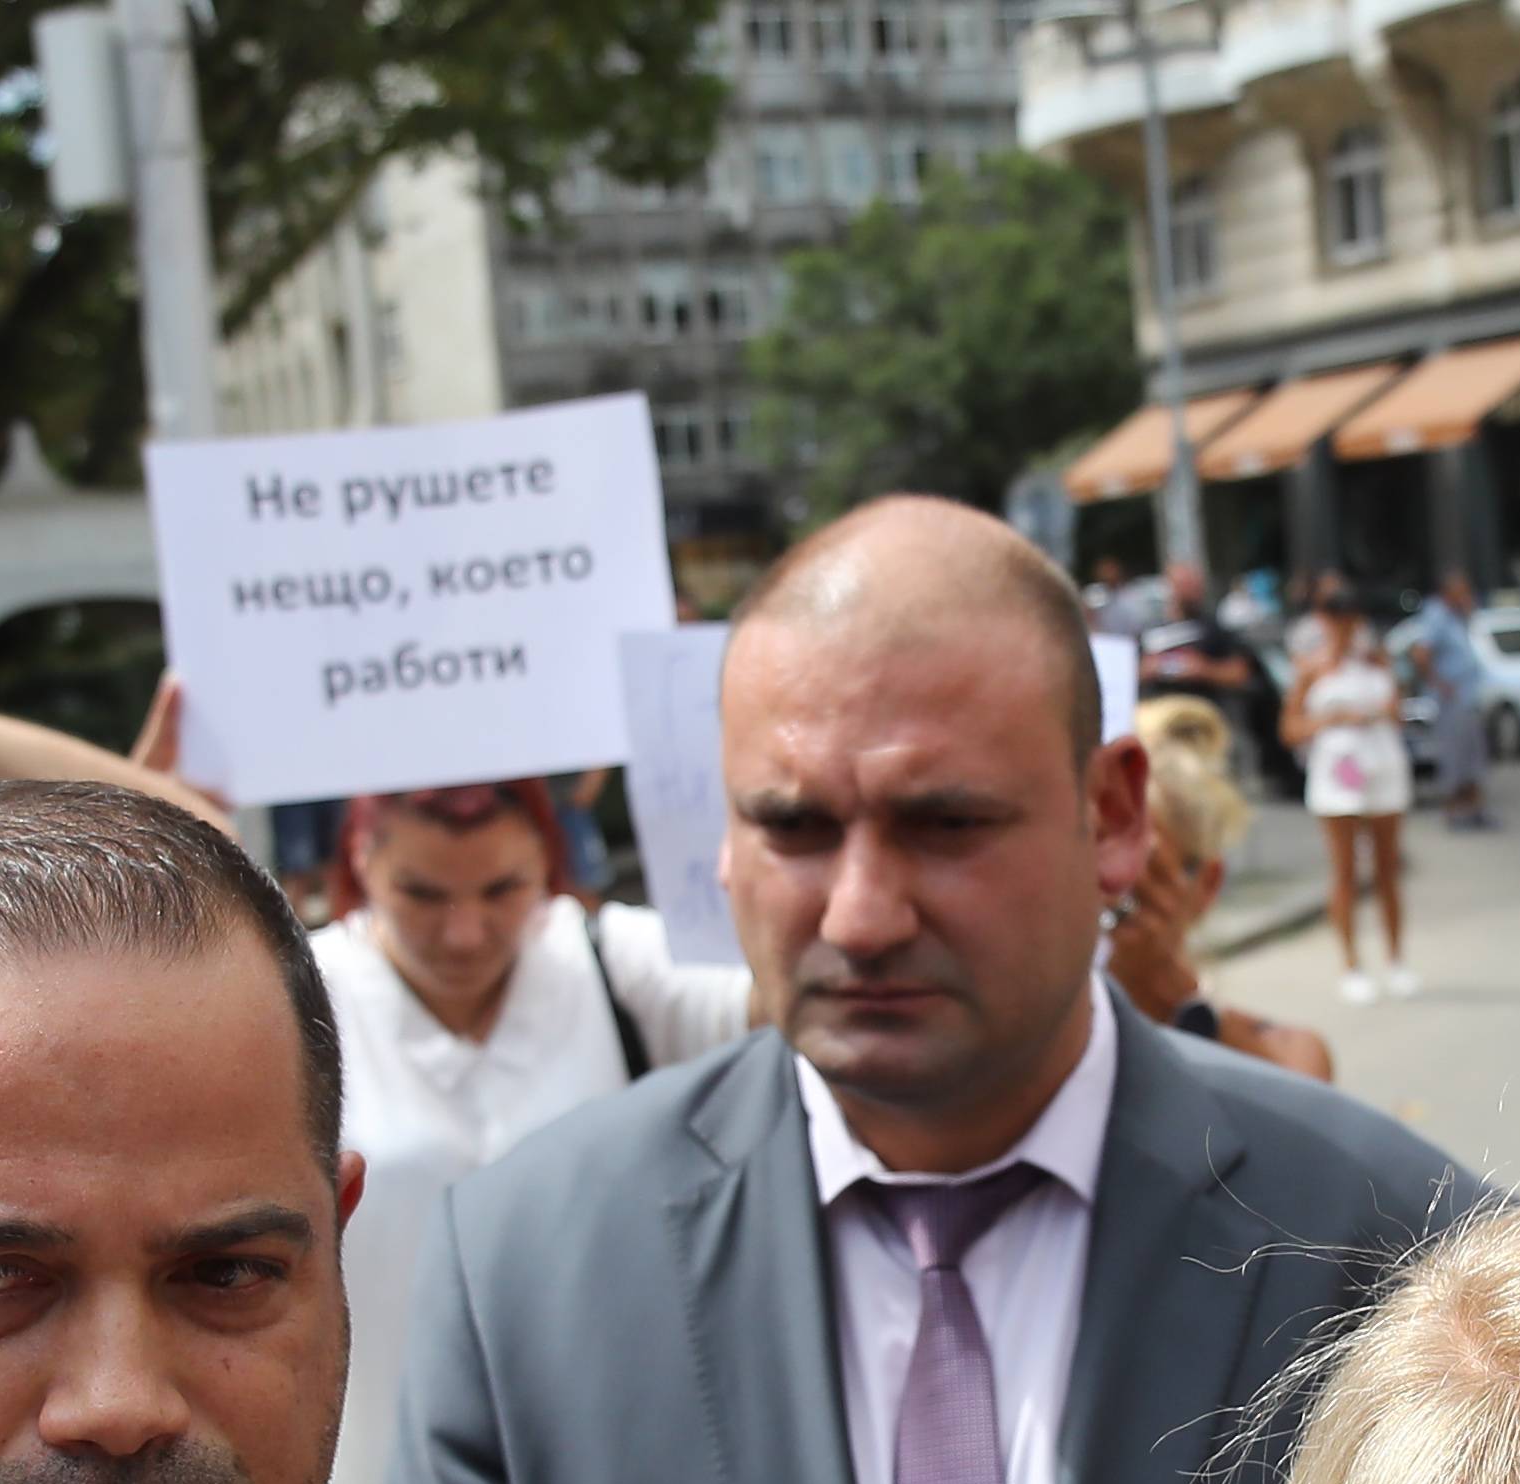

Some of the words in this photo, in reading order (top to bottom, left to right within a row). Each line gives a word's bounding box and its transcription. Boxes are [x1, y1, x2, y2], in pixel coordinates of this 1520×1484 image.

[245, 471, 321, 520] Не
[341, 457, 555, 524] рушете
[233, 565, 410, 614] нещо,
[429, 545, 594, 597] което
[322, 640, 527, 709] работи
